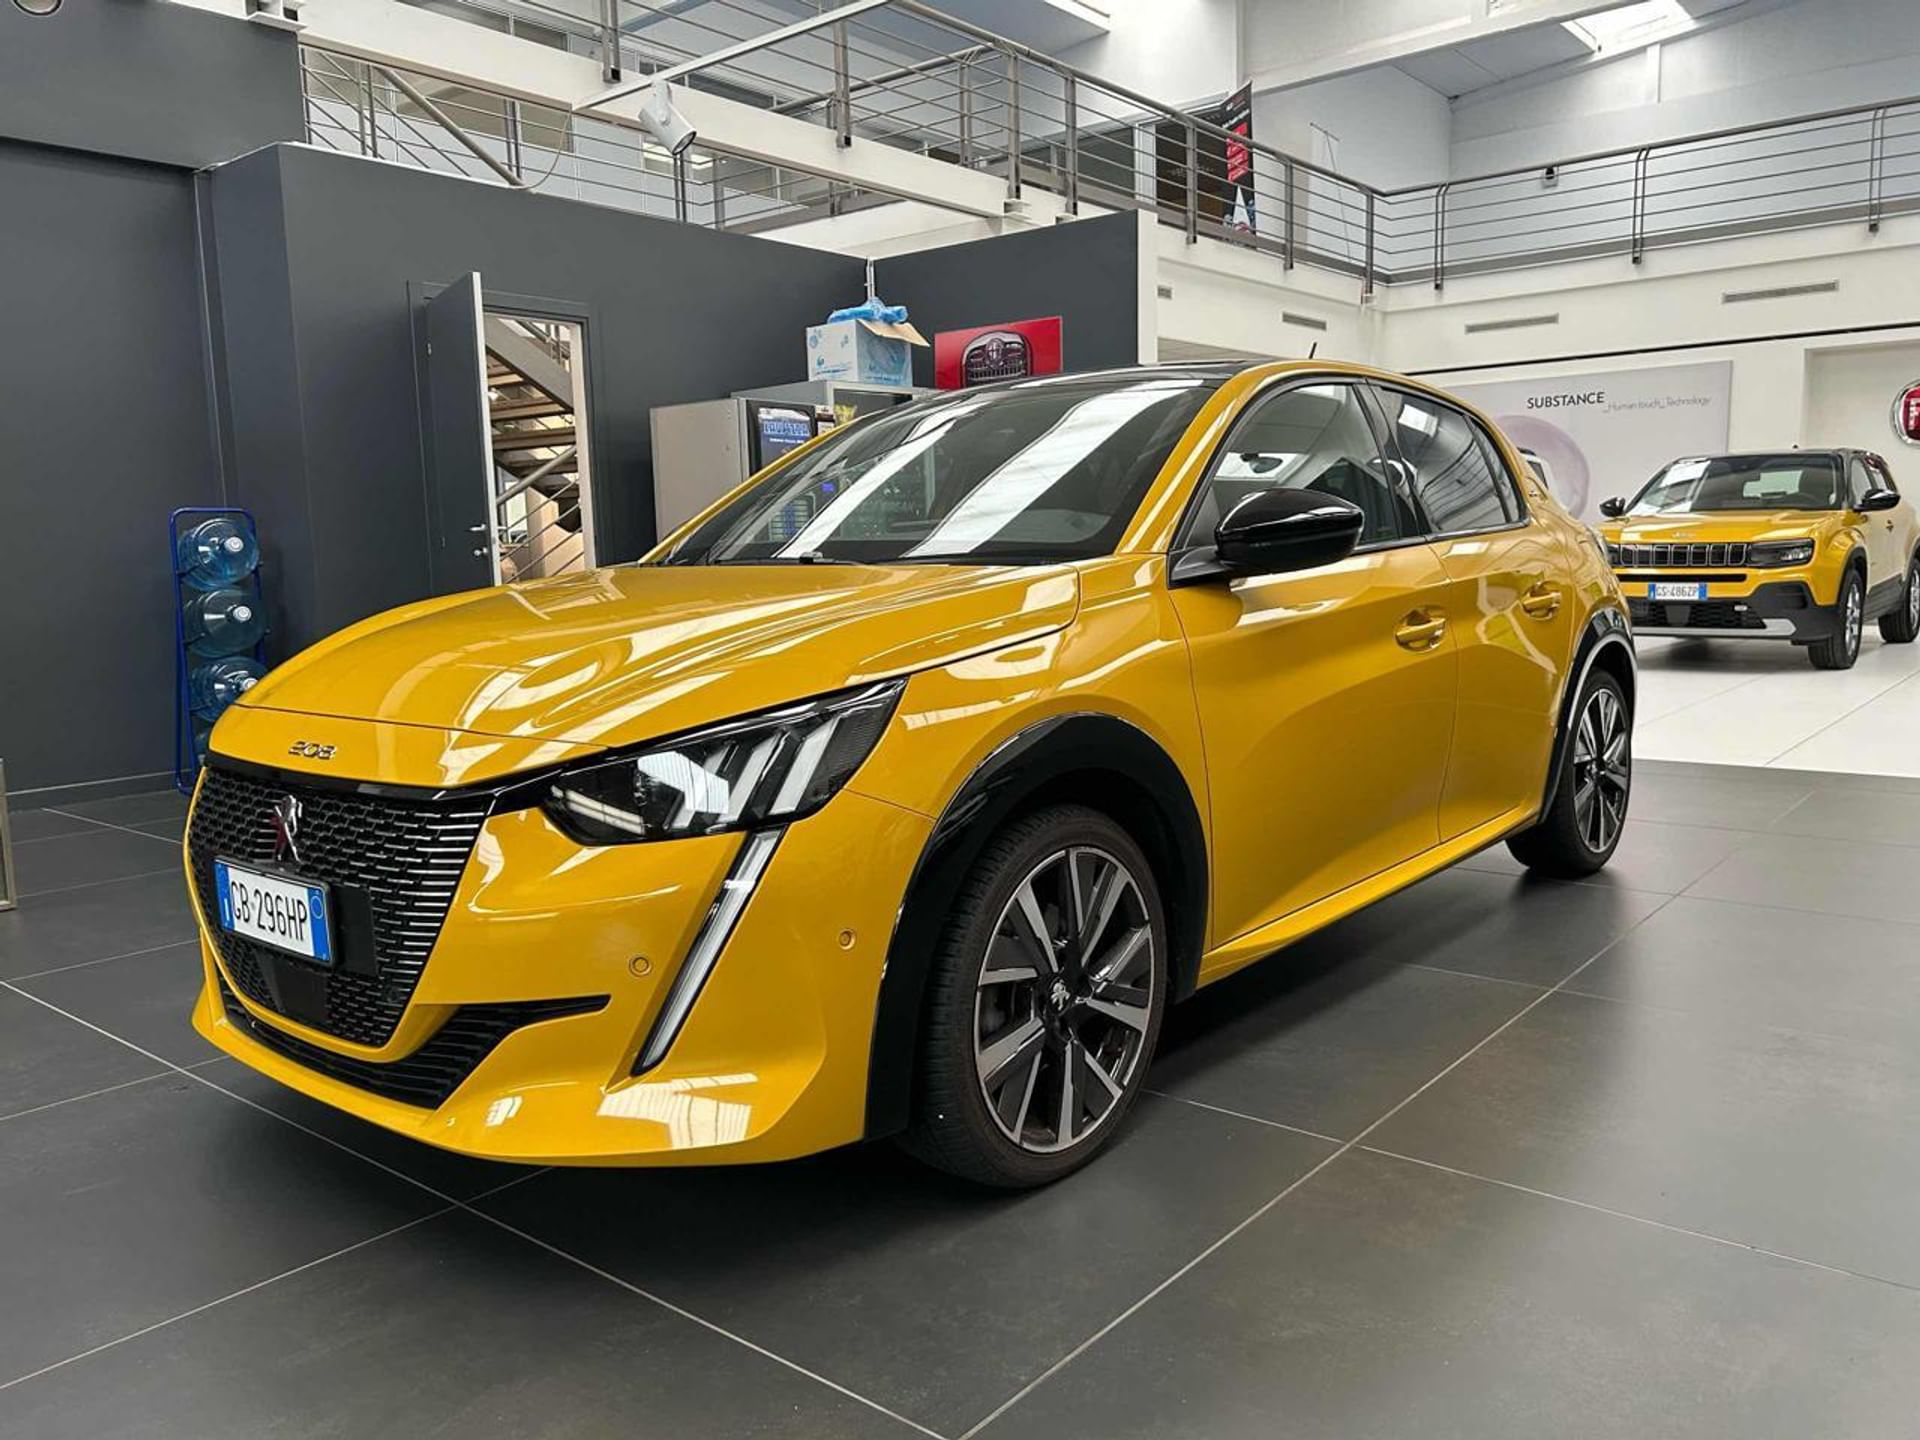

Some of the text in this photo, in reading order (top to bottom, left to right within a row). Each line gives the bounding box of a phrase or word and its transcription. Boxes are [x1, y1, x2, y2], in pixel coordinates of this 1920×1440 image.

[1527, 391, 1606, 410] SUBSTANCE
[288, 741, 336, 760] 208
[254, 889, 307, 941] 296HP
